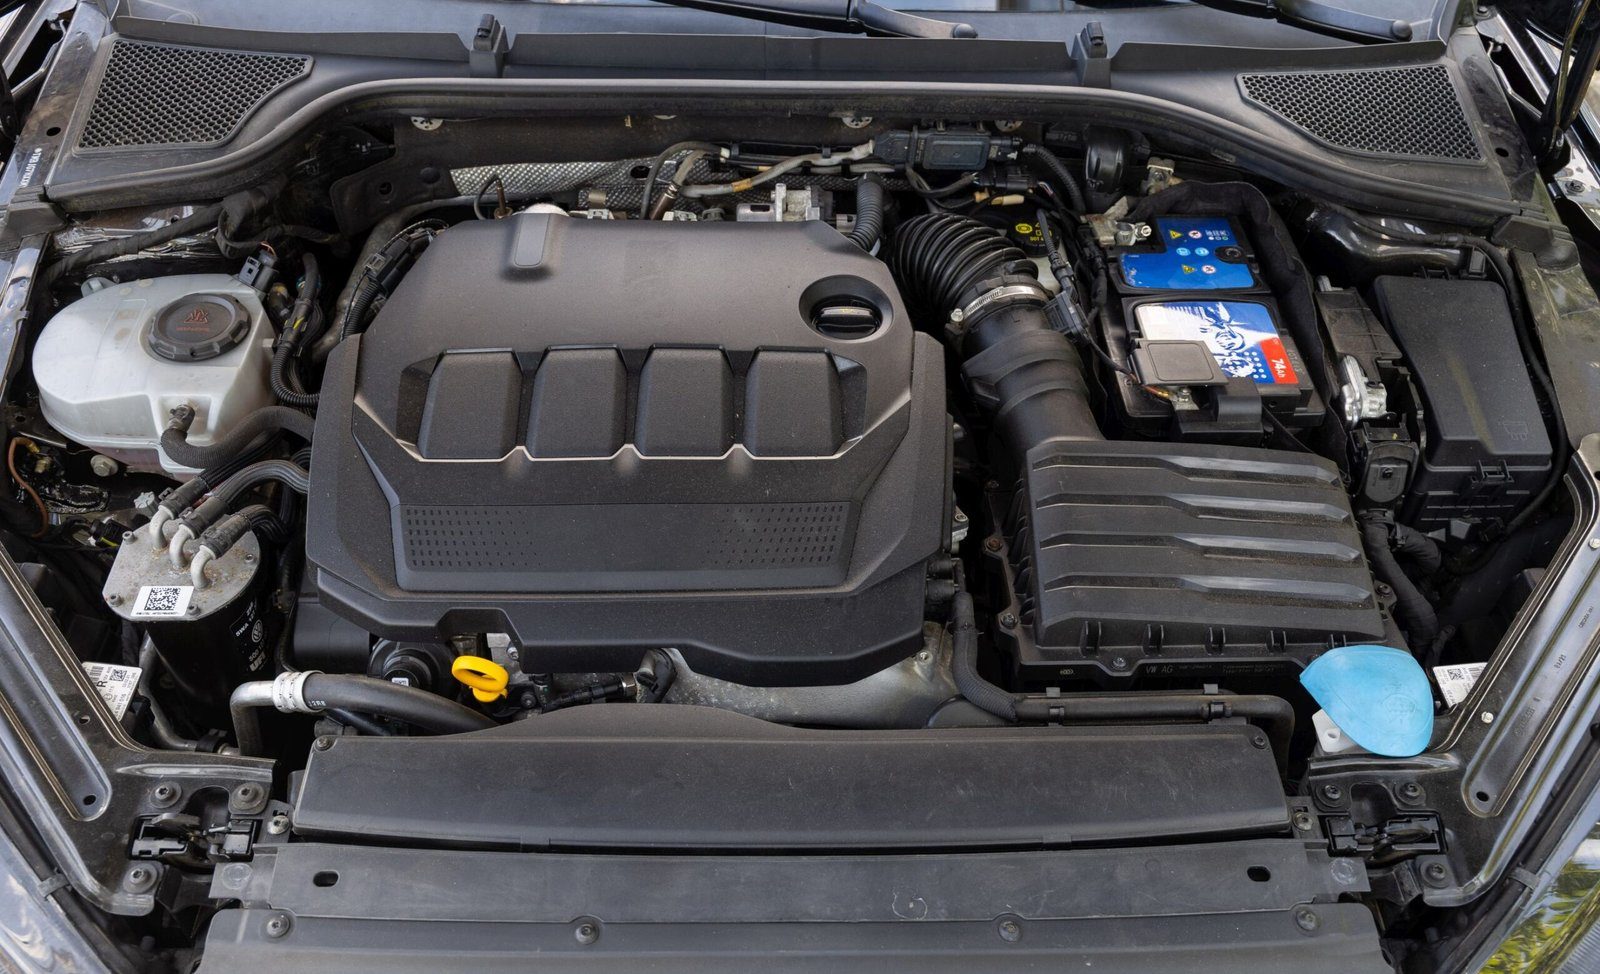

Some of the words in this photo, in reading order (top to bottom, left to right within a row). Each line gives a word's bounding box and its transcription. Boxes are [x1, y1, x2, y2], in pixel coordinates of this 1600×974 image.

[1145, 665, 1157, 674] VW
[1161, 664, 1174, 673] AG
[96, 680, 108, 688] R
